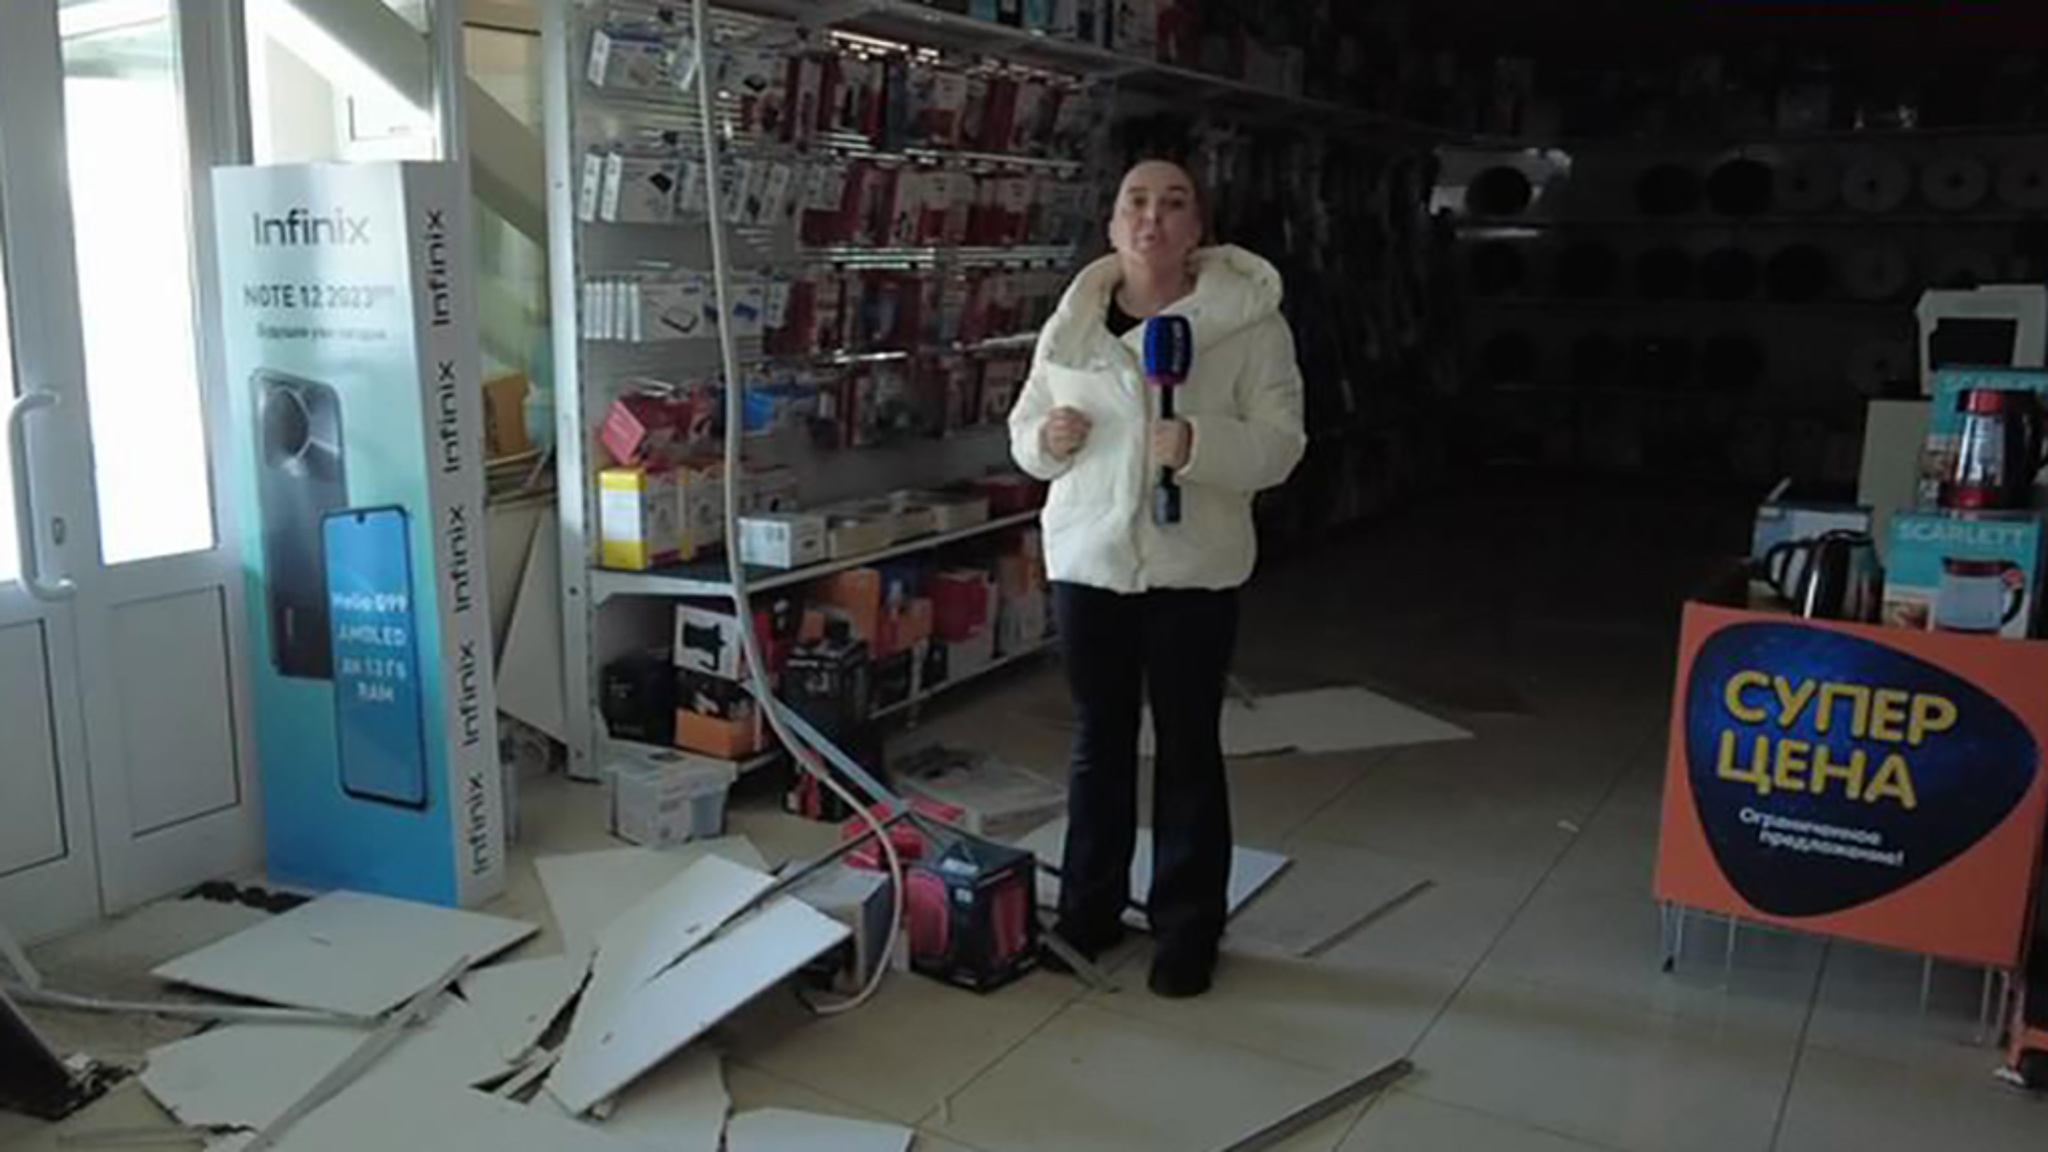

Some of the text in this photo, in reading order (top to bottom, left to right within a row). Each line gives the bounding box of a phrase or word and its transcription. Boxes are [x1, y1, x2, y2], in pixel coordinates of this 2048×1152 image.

[253, 207, 371, 247] Infinix
[425, 209, 450, 326] Infinix
[244, 285, 296, 308] NOTE
[300, 286, 323, 308] 12
[437, 361, 461, 473] Infinix
[447, 505, 471, 613] Infinix
[453, 640, 479, 747] Infinix
[1725, 670, 1958, 746] СУПЕР
[1717, 729, 1917, 809] ЦЕНА
[466, 772, 490, 875] Infinix
